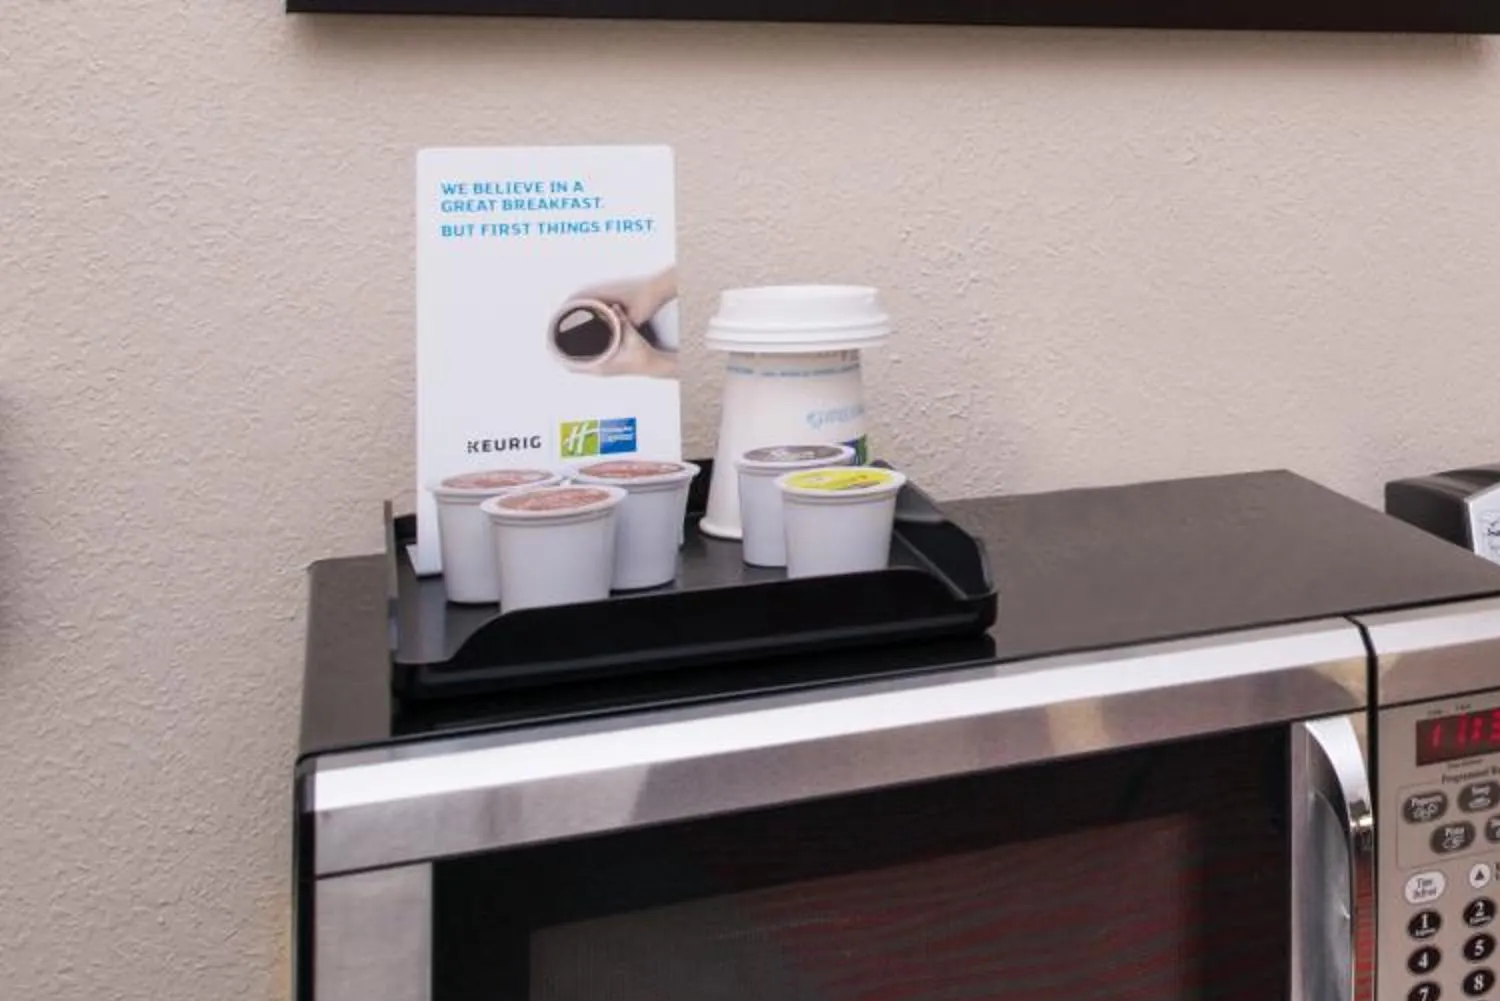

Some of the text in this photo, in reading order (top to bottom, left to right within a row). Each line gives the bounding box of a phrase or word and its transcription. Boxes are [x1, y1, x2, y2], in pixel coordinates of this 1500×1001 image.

[441, 181, 584, 195] WE BELIEVE IN A
[441, 200, 496, 213] GREAT
[441, 224, 475, 237] BUT
[481, 222, 530, 237] FIRST
[538, 220, 600, 235] THINGS
[467, 436, 542, 454] KEURIG
[1475, 900, 1485, 917] 2
[1421, 914, 1429, 930] 1
[1475, 938, 1485, 956] 5
[1418, 952, 1430, 970] 4
[1473, 973, 1484, 992] 8
